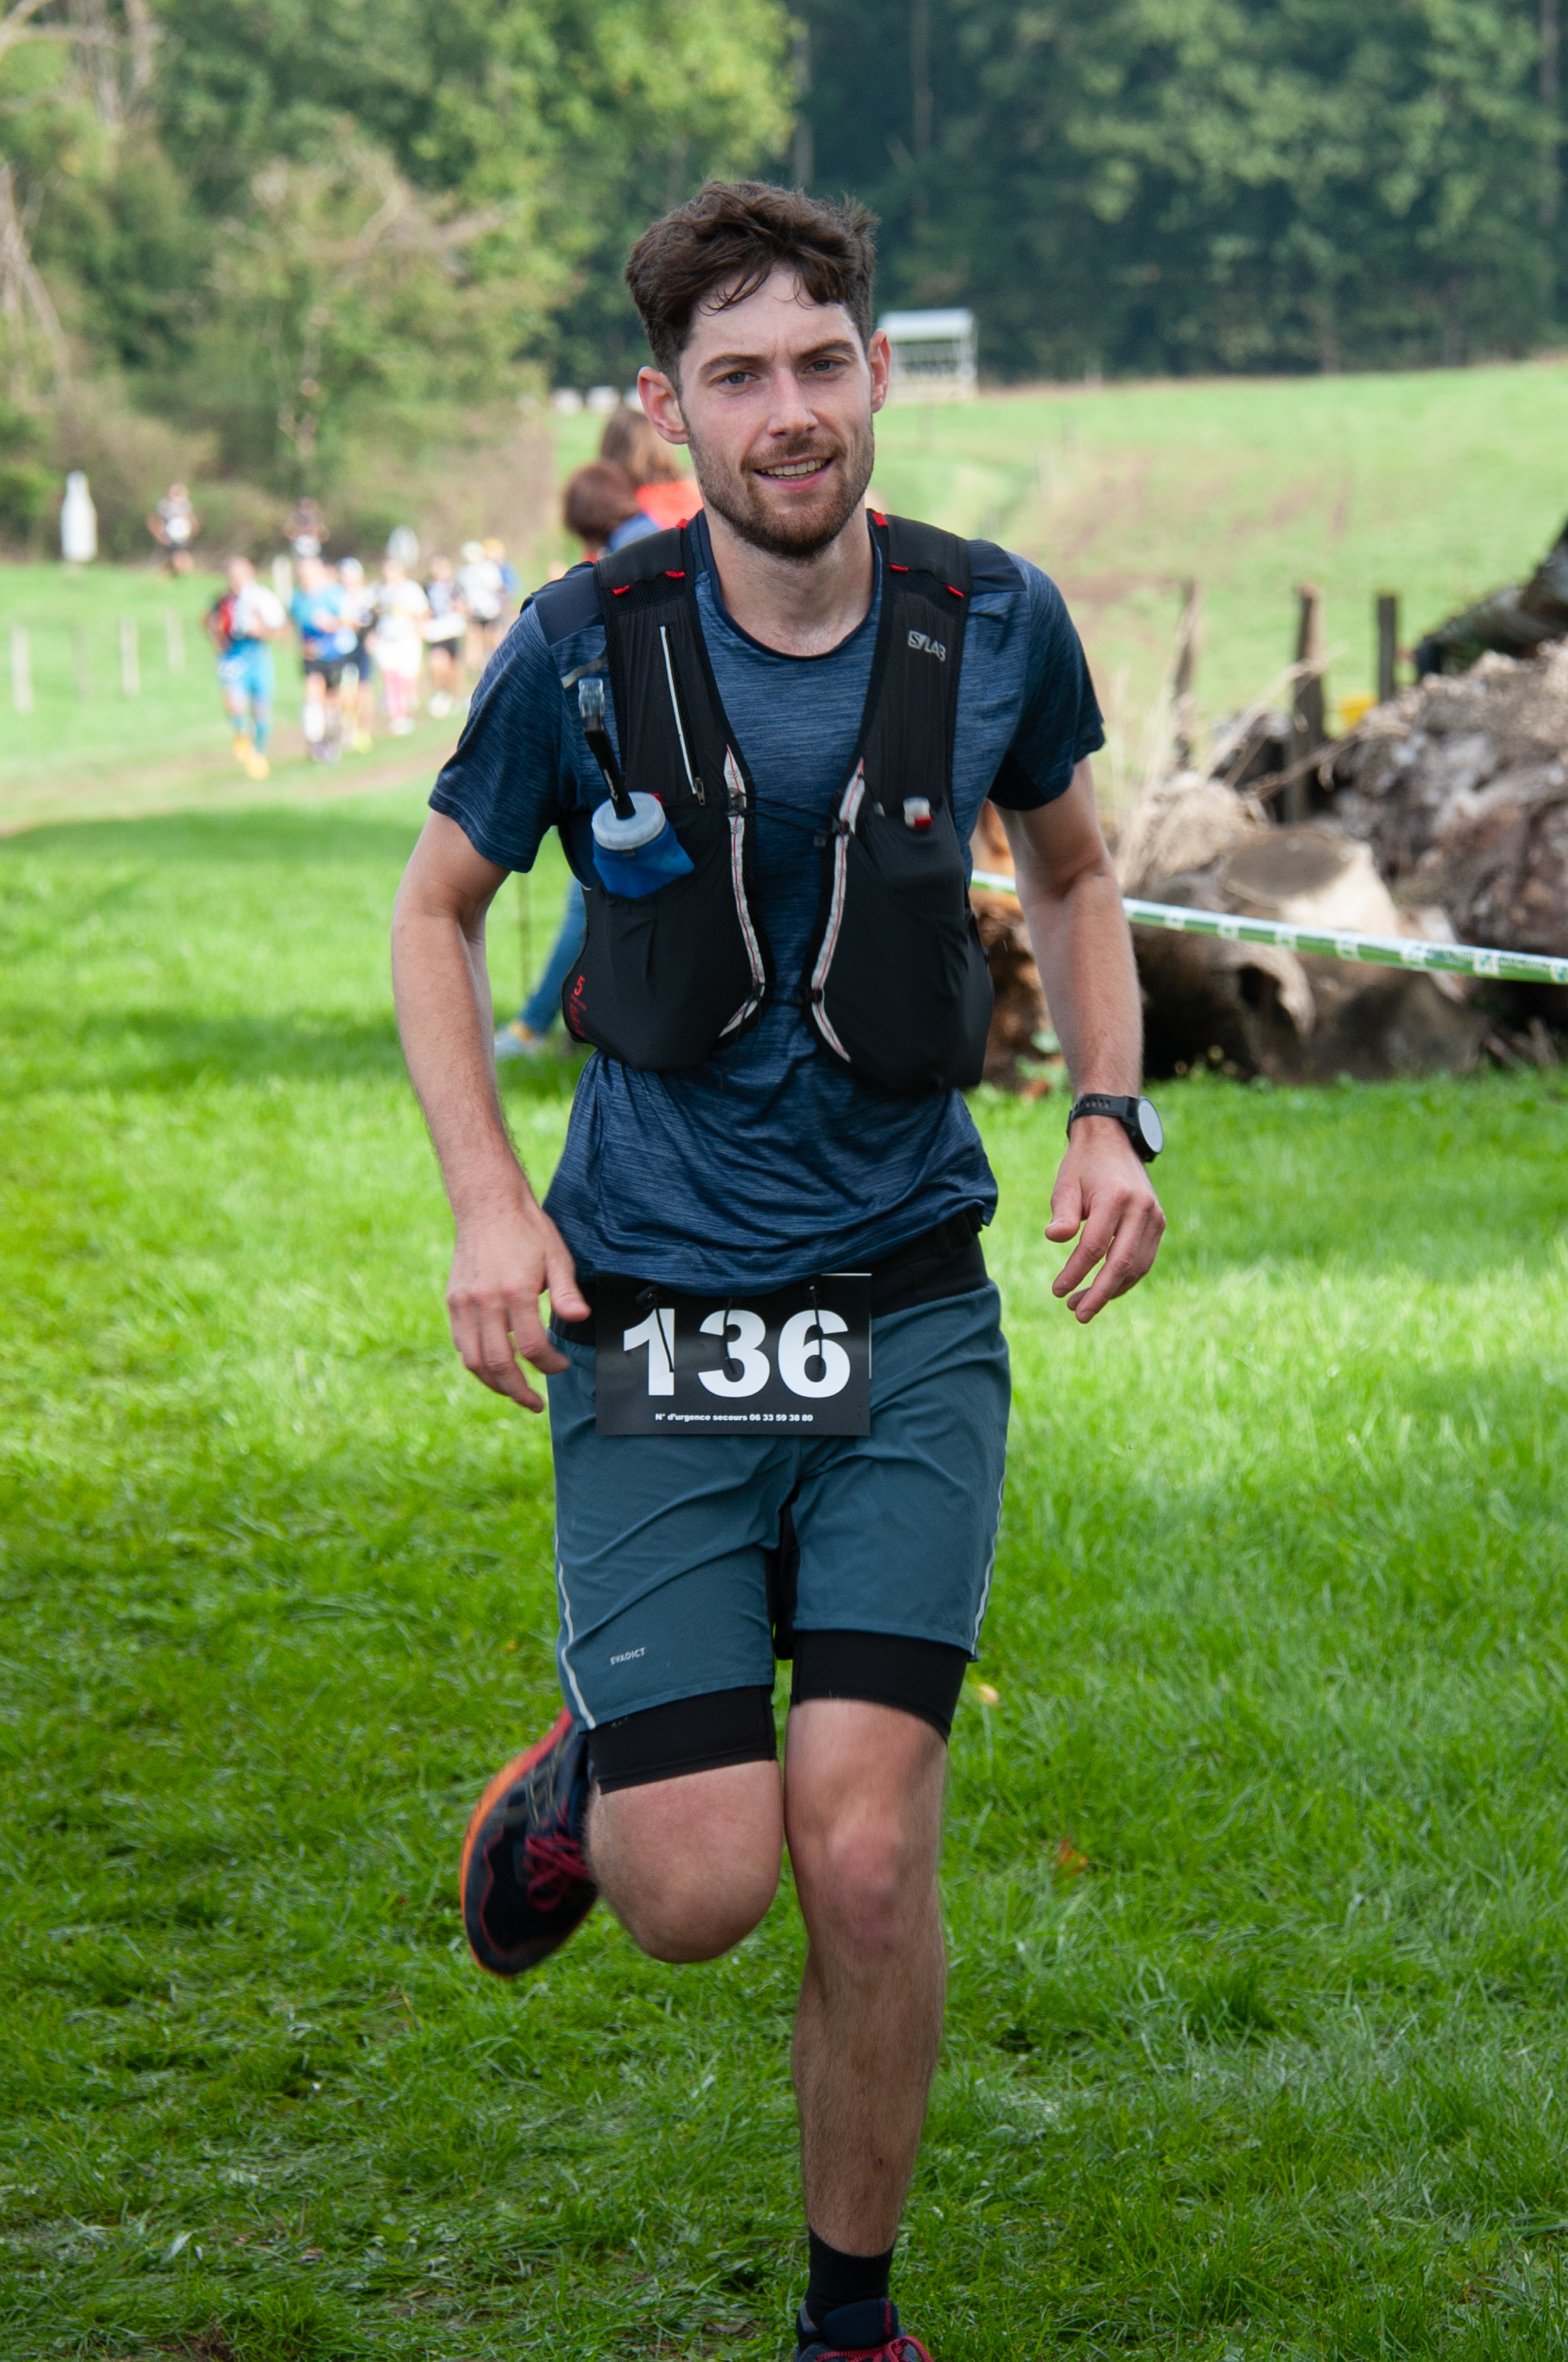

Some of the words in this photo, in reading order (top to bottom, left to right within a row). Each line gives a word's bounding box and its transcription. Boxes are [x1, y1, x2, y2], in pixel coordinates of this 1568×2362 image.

[623, 1308, 851, 1398] 136
[667, 1413, 711, 1422] d'urgence
[749, 1414, 761, 1422] 06
[762, 1414, 774, 1422] 33
[775, 1414, 787, 1422] 59
[788, 1414, 800, 1422] 38
[801, 1414, 814, 1422] 80
